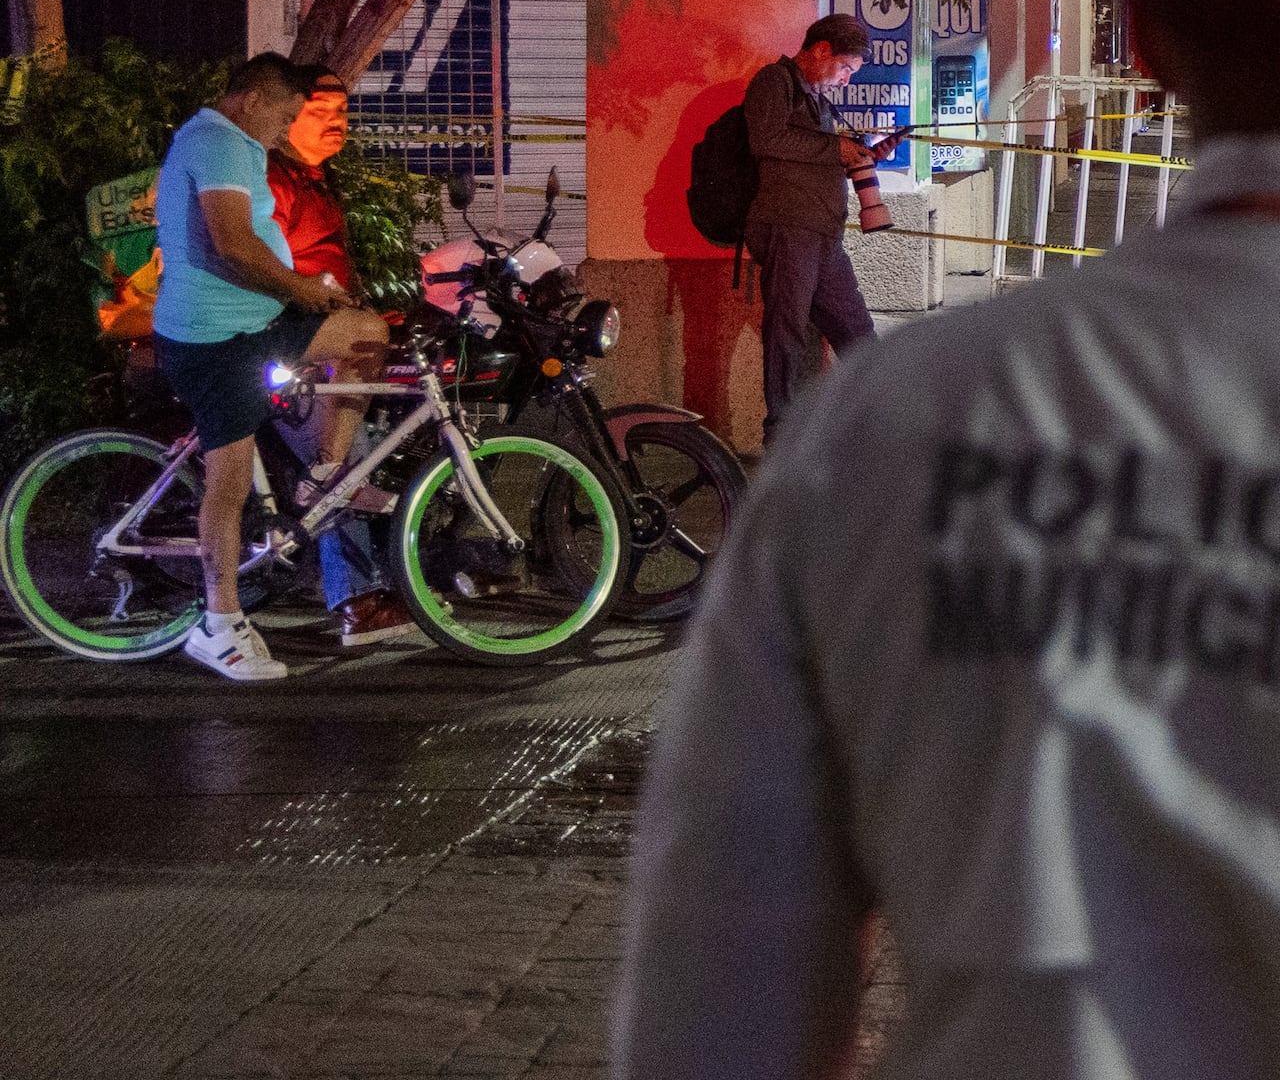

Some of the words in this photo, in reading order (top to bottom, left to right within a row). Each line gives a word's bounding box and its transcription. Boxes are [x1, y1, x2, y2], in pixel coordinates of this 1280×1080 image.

[872, 39, 908, 66] TOS
[847, 83, 910, 107] REVISAR
[842, 107, 875, 130] URÓ
[877, 111, 896, 133] DE
[931, 145, 963, 157] ORRO
